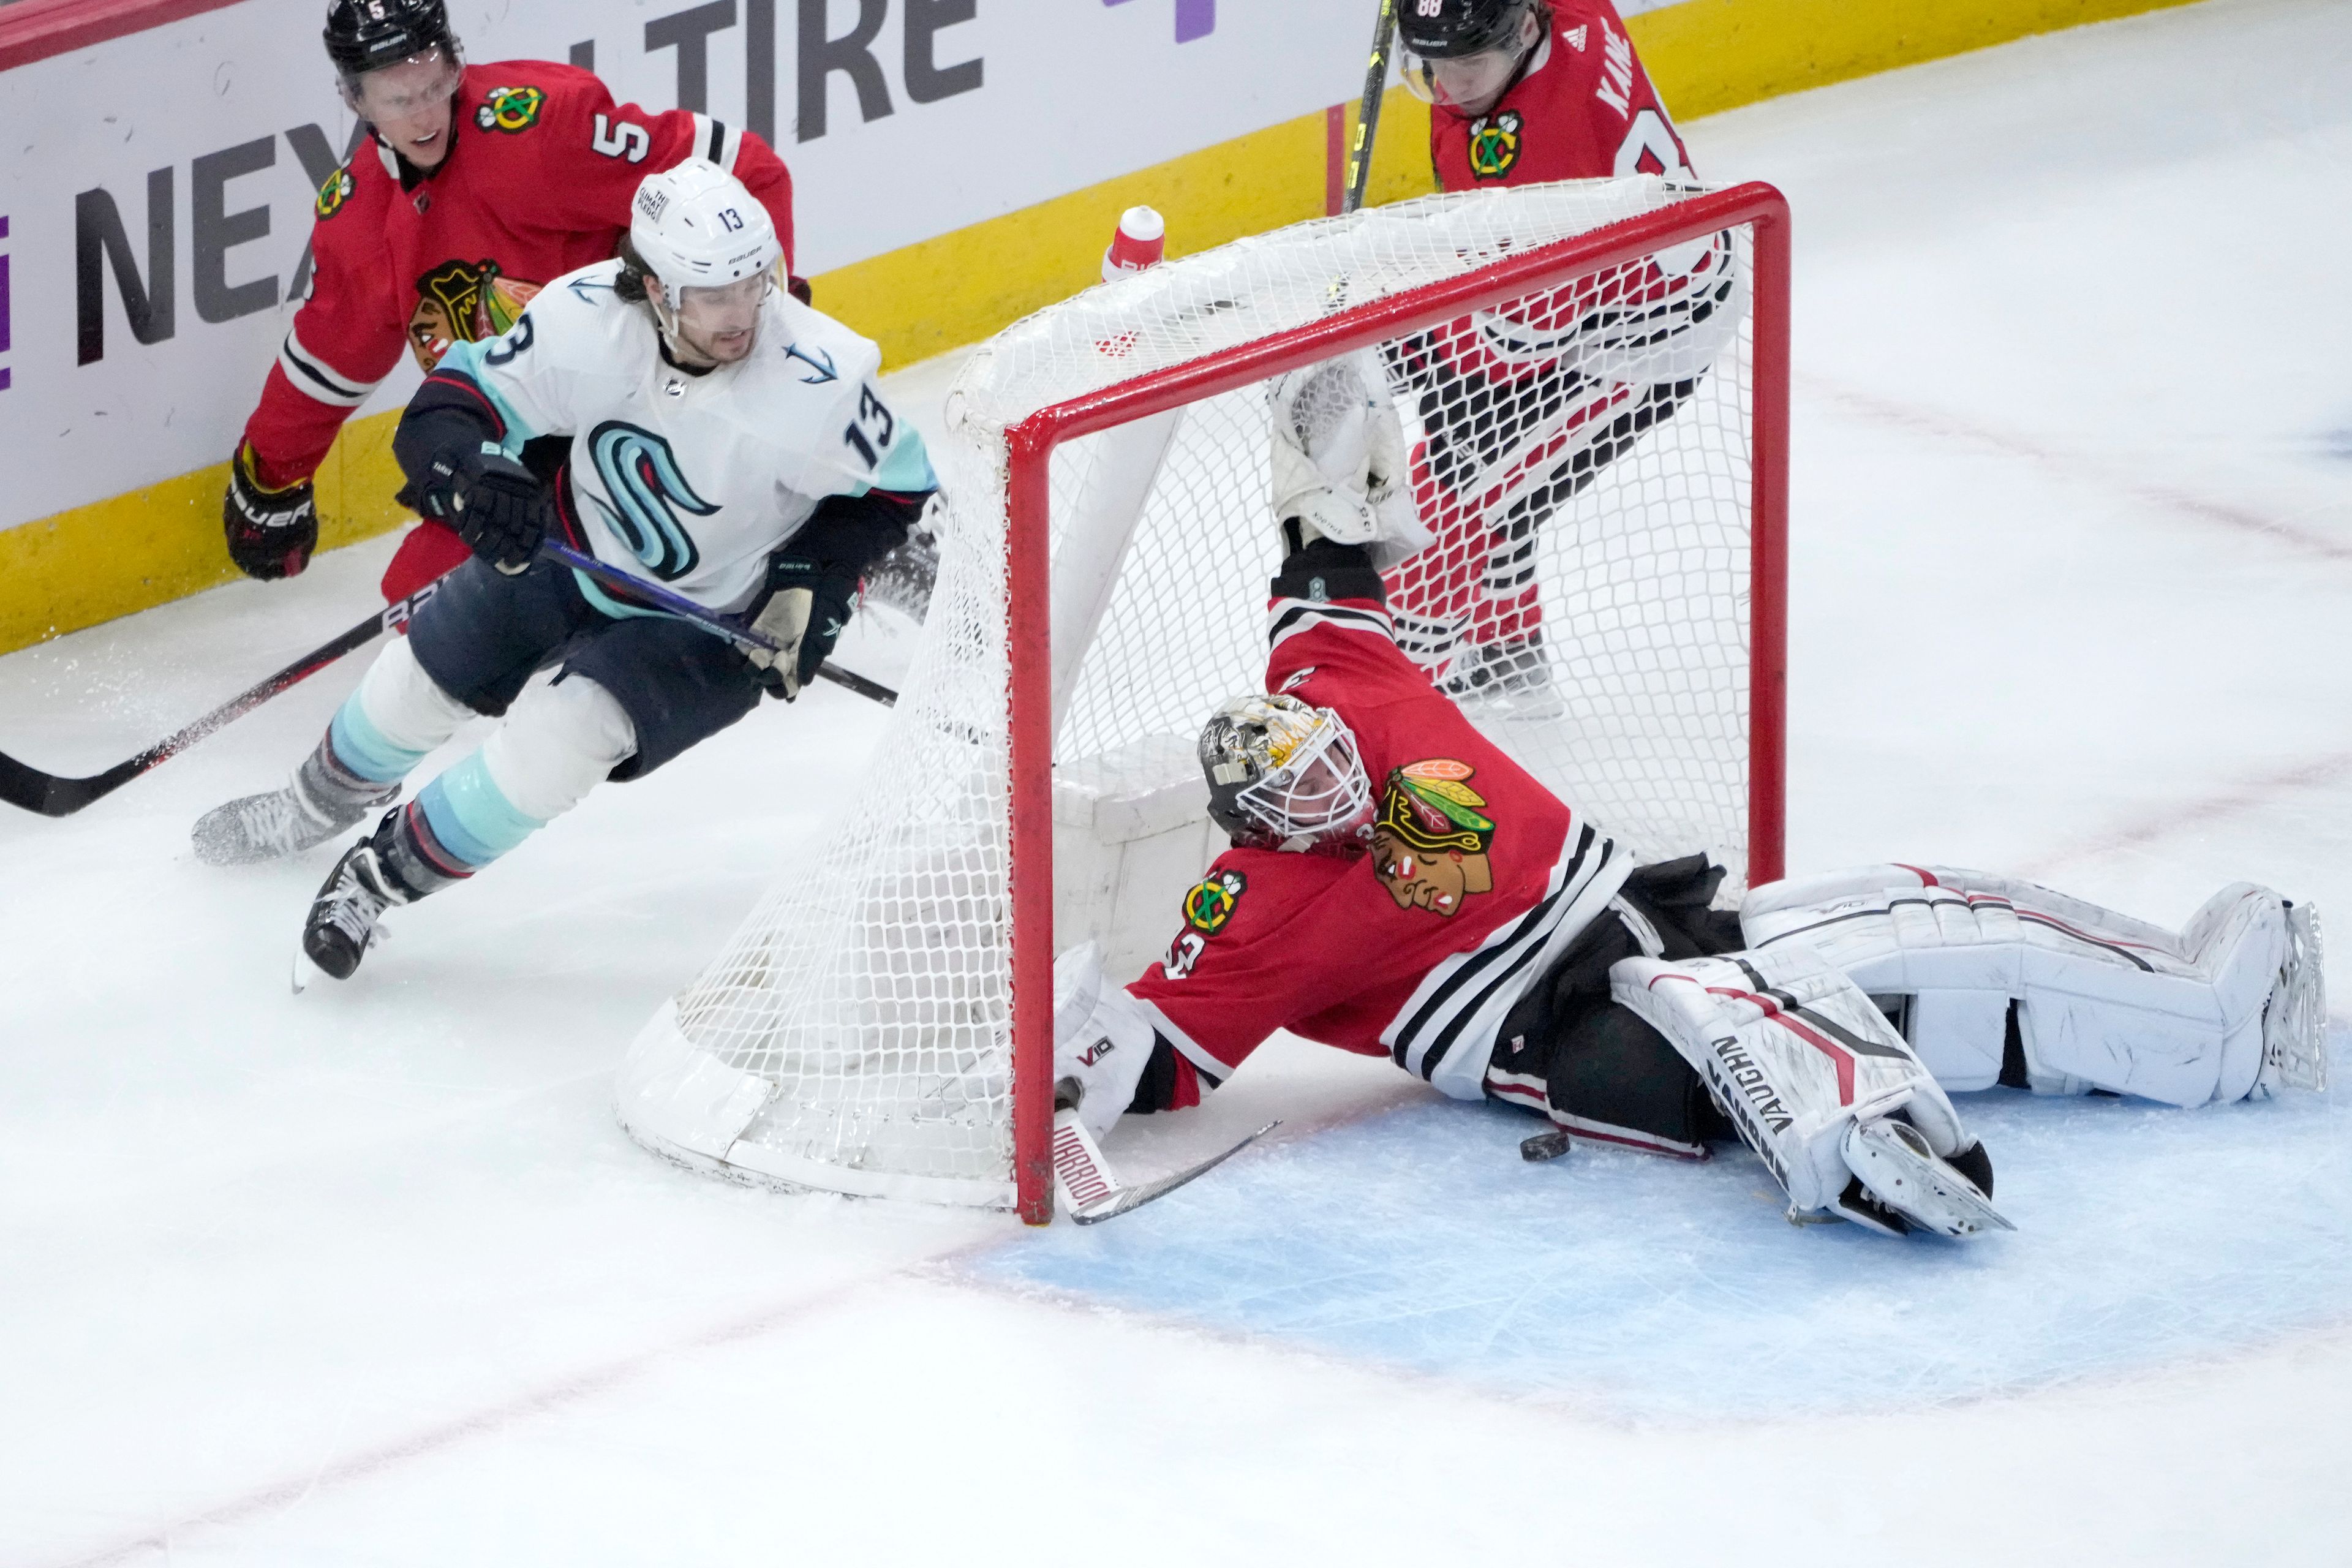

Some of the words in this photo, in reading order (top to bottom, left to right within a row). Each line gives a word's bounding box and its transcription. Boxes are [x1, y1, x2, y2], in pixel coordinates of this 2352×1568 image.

[368, 0, 385, 20] 5
[1417, 0, 1443, 17] 88
[645, 0, 984, 151] TIRE
[592, 114, 650, 164] 5
[718, 208, 744, 233] 13
[728, 245, 763, 266] BAUER
[843, 382, 895, 471] 13
[1165, 932, 1205, 981] 2
[1711, 1035, 1794, 1136] VAUGHN
